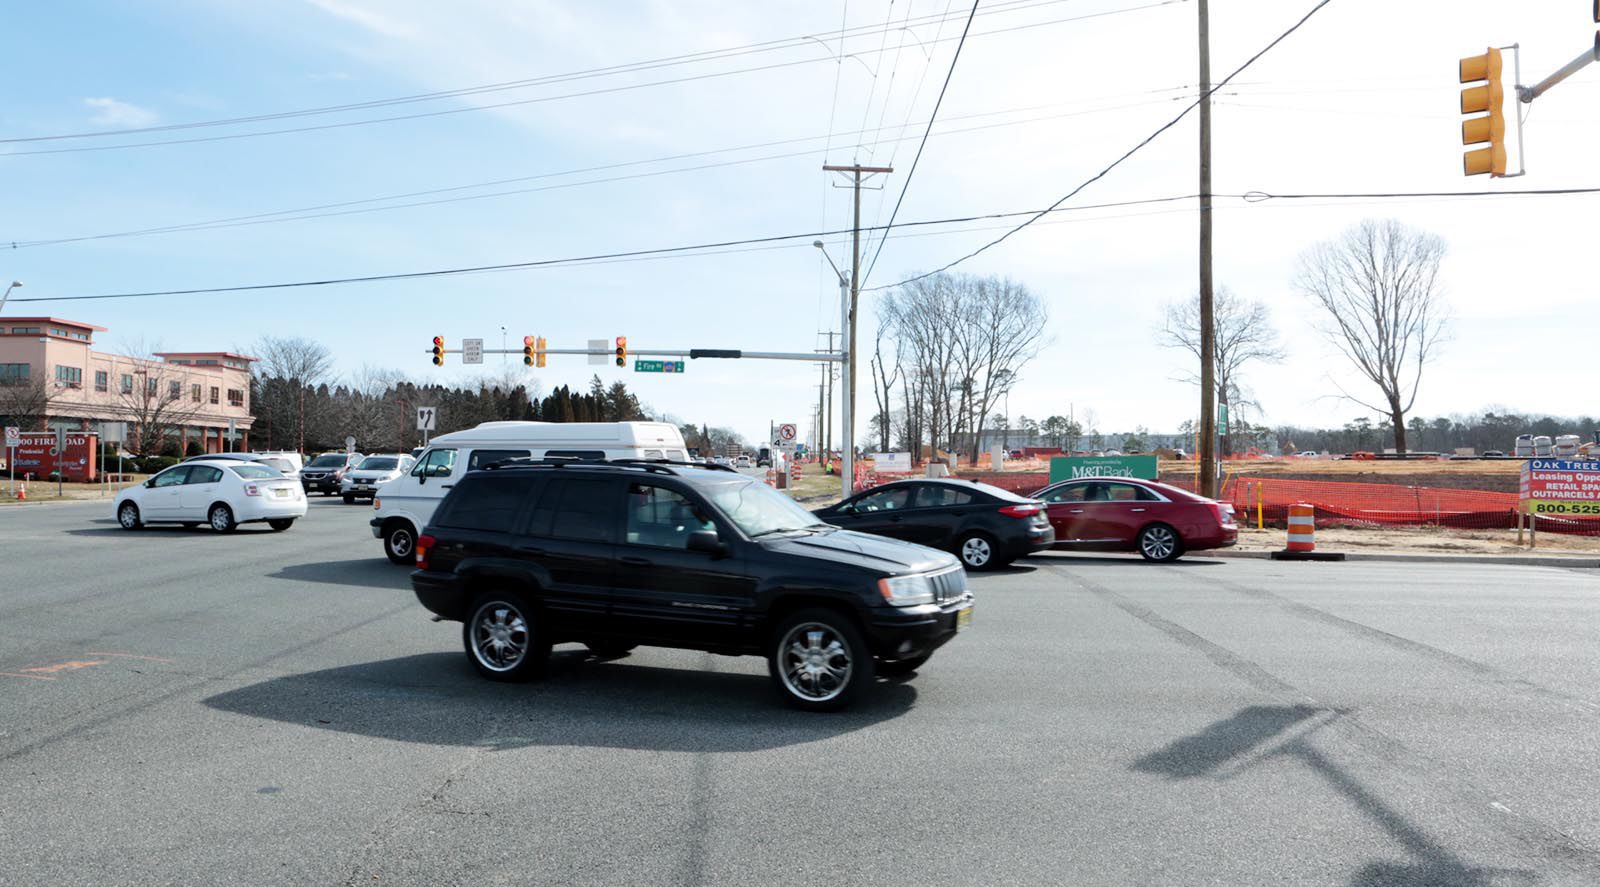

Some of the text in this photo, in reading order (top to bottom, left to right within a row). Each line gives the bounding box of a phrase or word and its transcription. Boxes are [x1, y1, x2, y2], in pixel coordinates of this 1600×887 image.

[643, 362, 655, 370] Fire
[34, 437, 56, 446] FIRE
[65, 437, 85, 446] OAD
[1532, 460, 1599, 470] OAK TREE
[1532, 472, 1573, 482] Leasing
[1546, 482, 1580, 490] RETAIL
[1532, 490, 1595, 499] OUTPARCELS
[1536, 503, 1600, 514] 800-525
